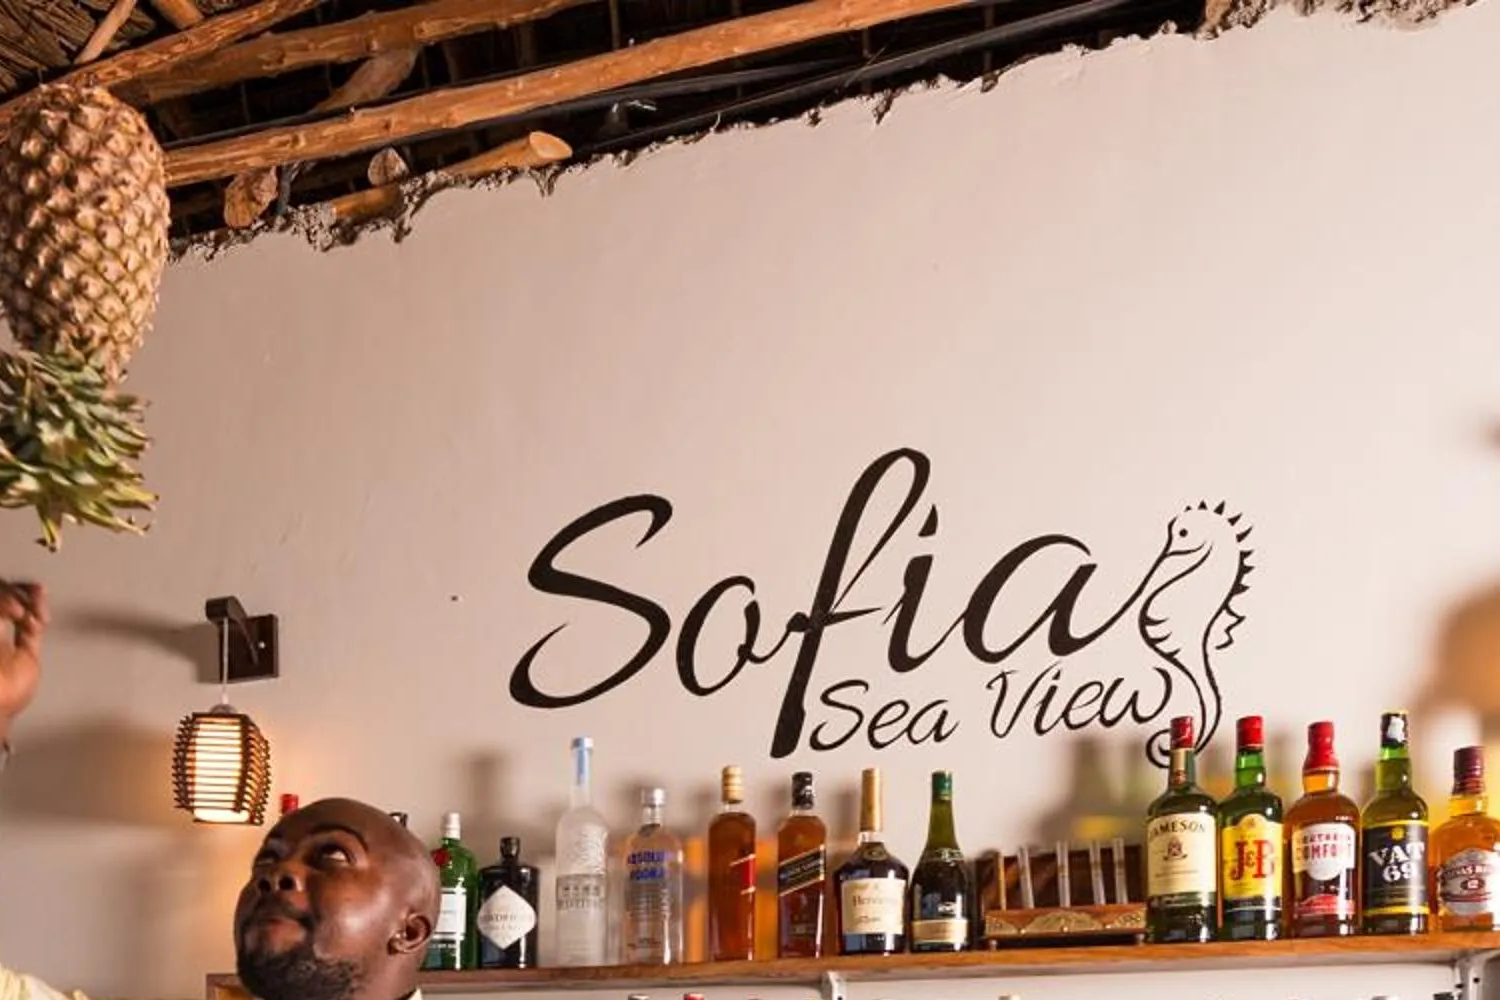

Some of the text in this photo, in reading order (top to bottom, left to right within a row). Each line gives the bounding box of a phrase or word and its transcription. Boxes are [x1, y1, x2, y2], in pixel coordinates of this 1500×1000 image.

[509, 447, 1132, 758] Sofia
[810, 665, 1175, 752] Sea View
[1151, 819, 1206, 836] AMESON
[1368, 842, 1425, 866] VAT
[1382, 861, 1418, 883] 69
